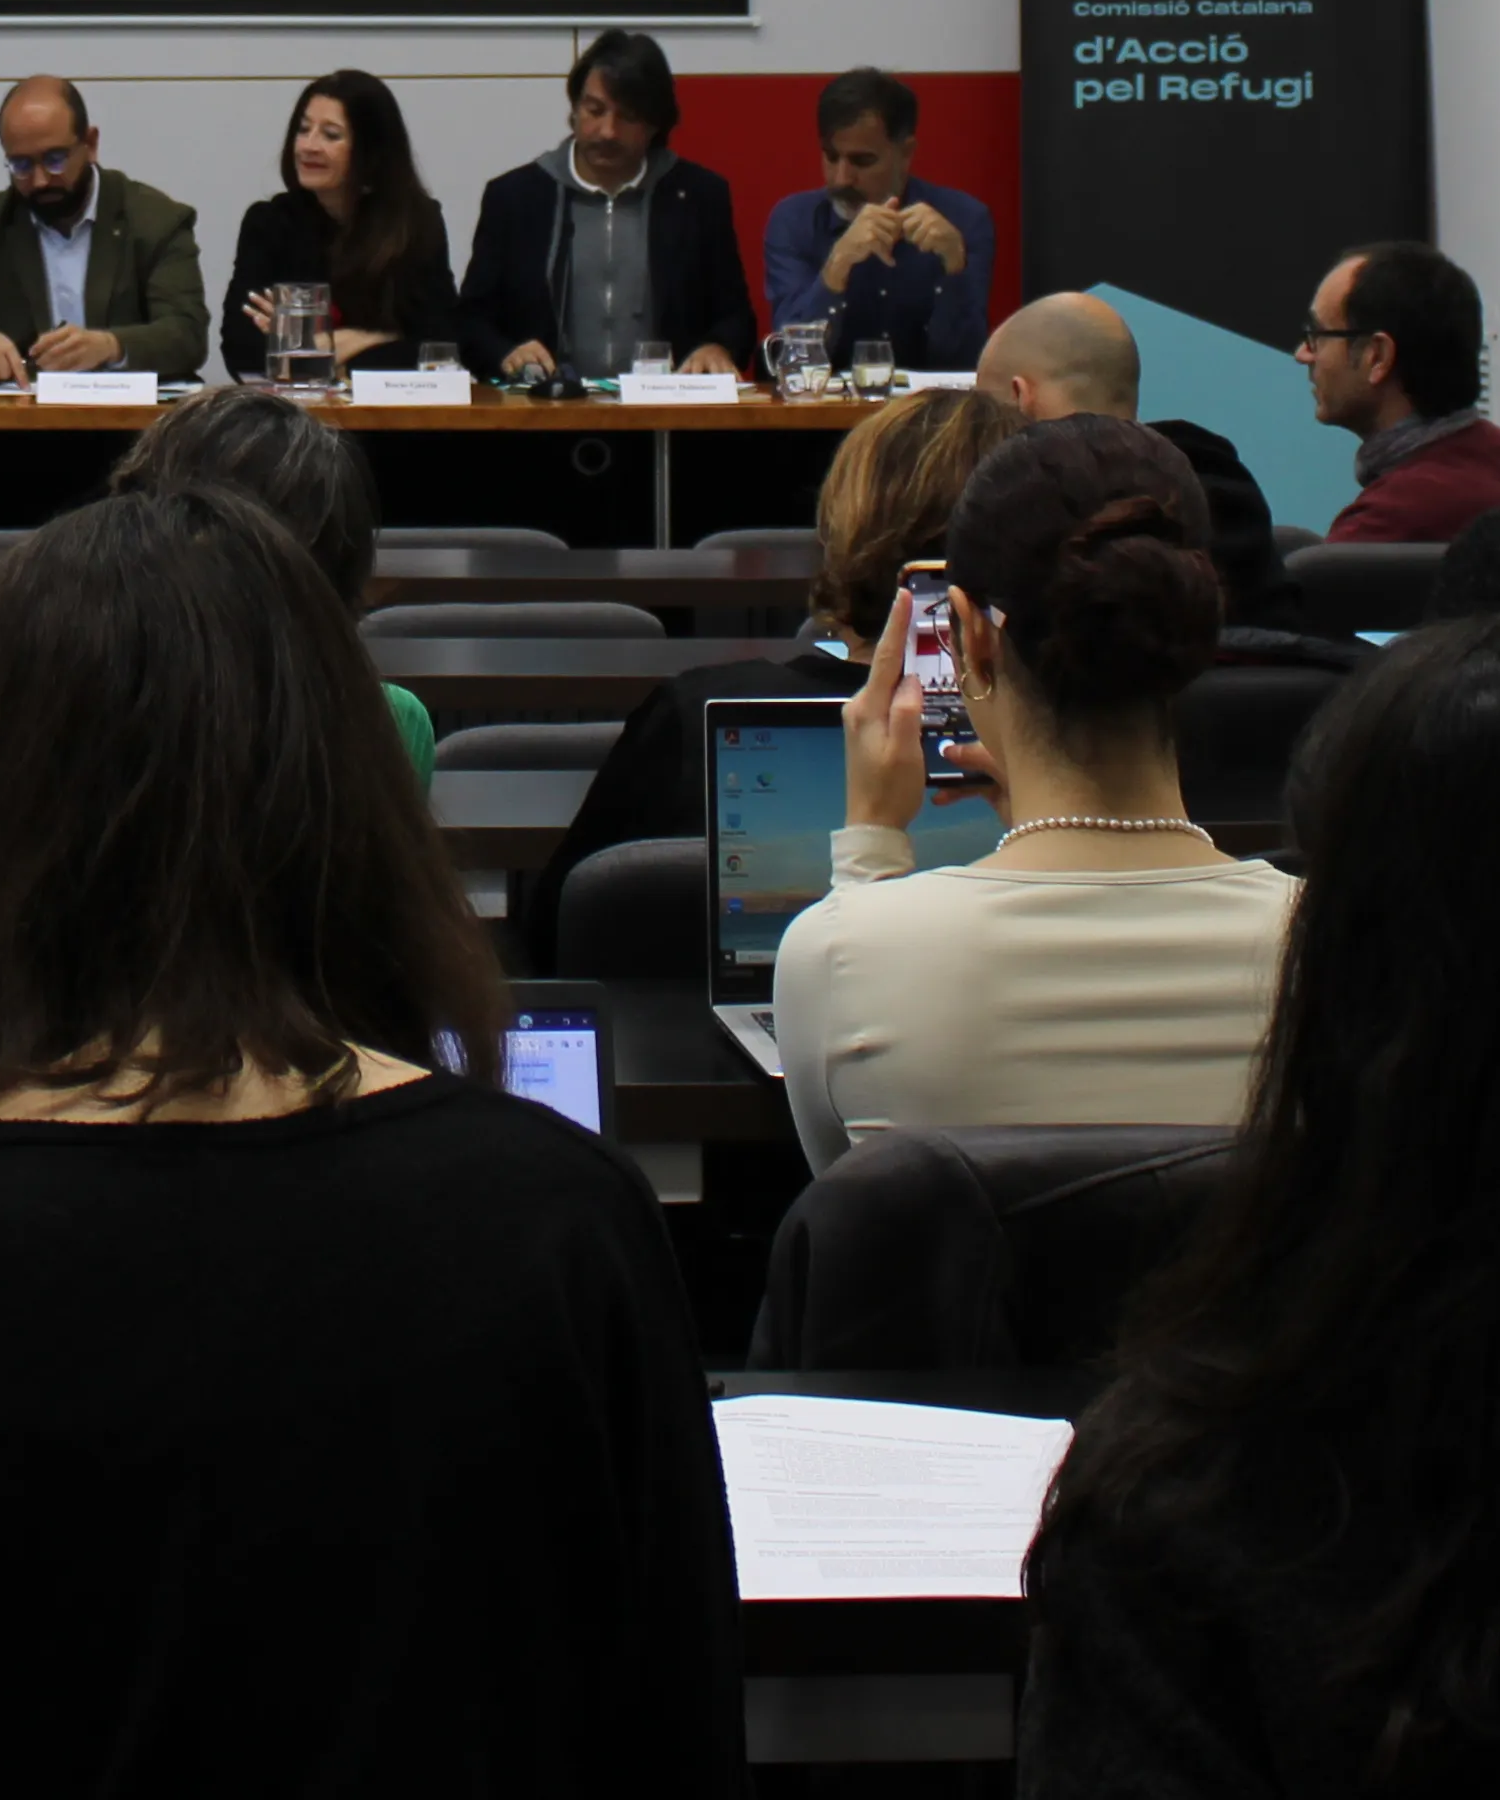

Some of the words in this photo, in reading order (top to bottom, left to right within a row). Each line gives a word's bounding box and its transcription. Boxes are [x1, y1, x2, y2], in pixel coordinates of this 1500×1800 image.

[1073, 0, 1190, 17] Comissió
[1196, 0, 1314, 15] Catalana
[1073, 33, 1249, 65] d'Acció
[1074, 73, 1145, 109] pel
[1159, 71, 1314, 109] Refugi
